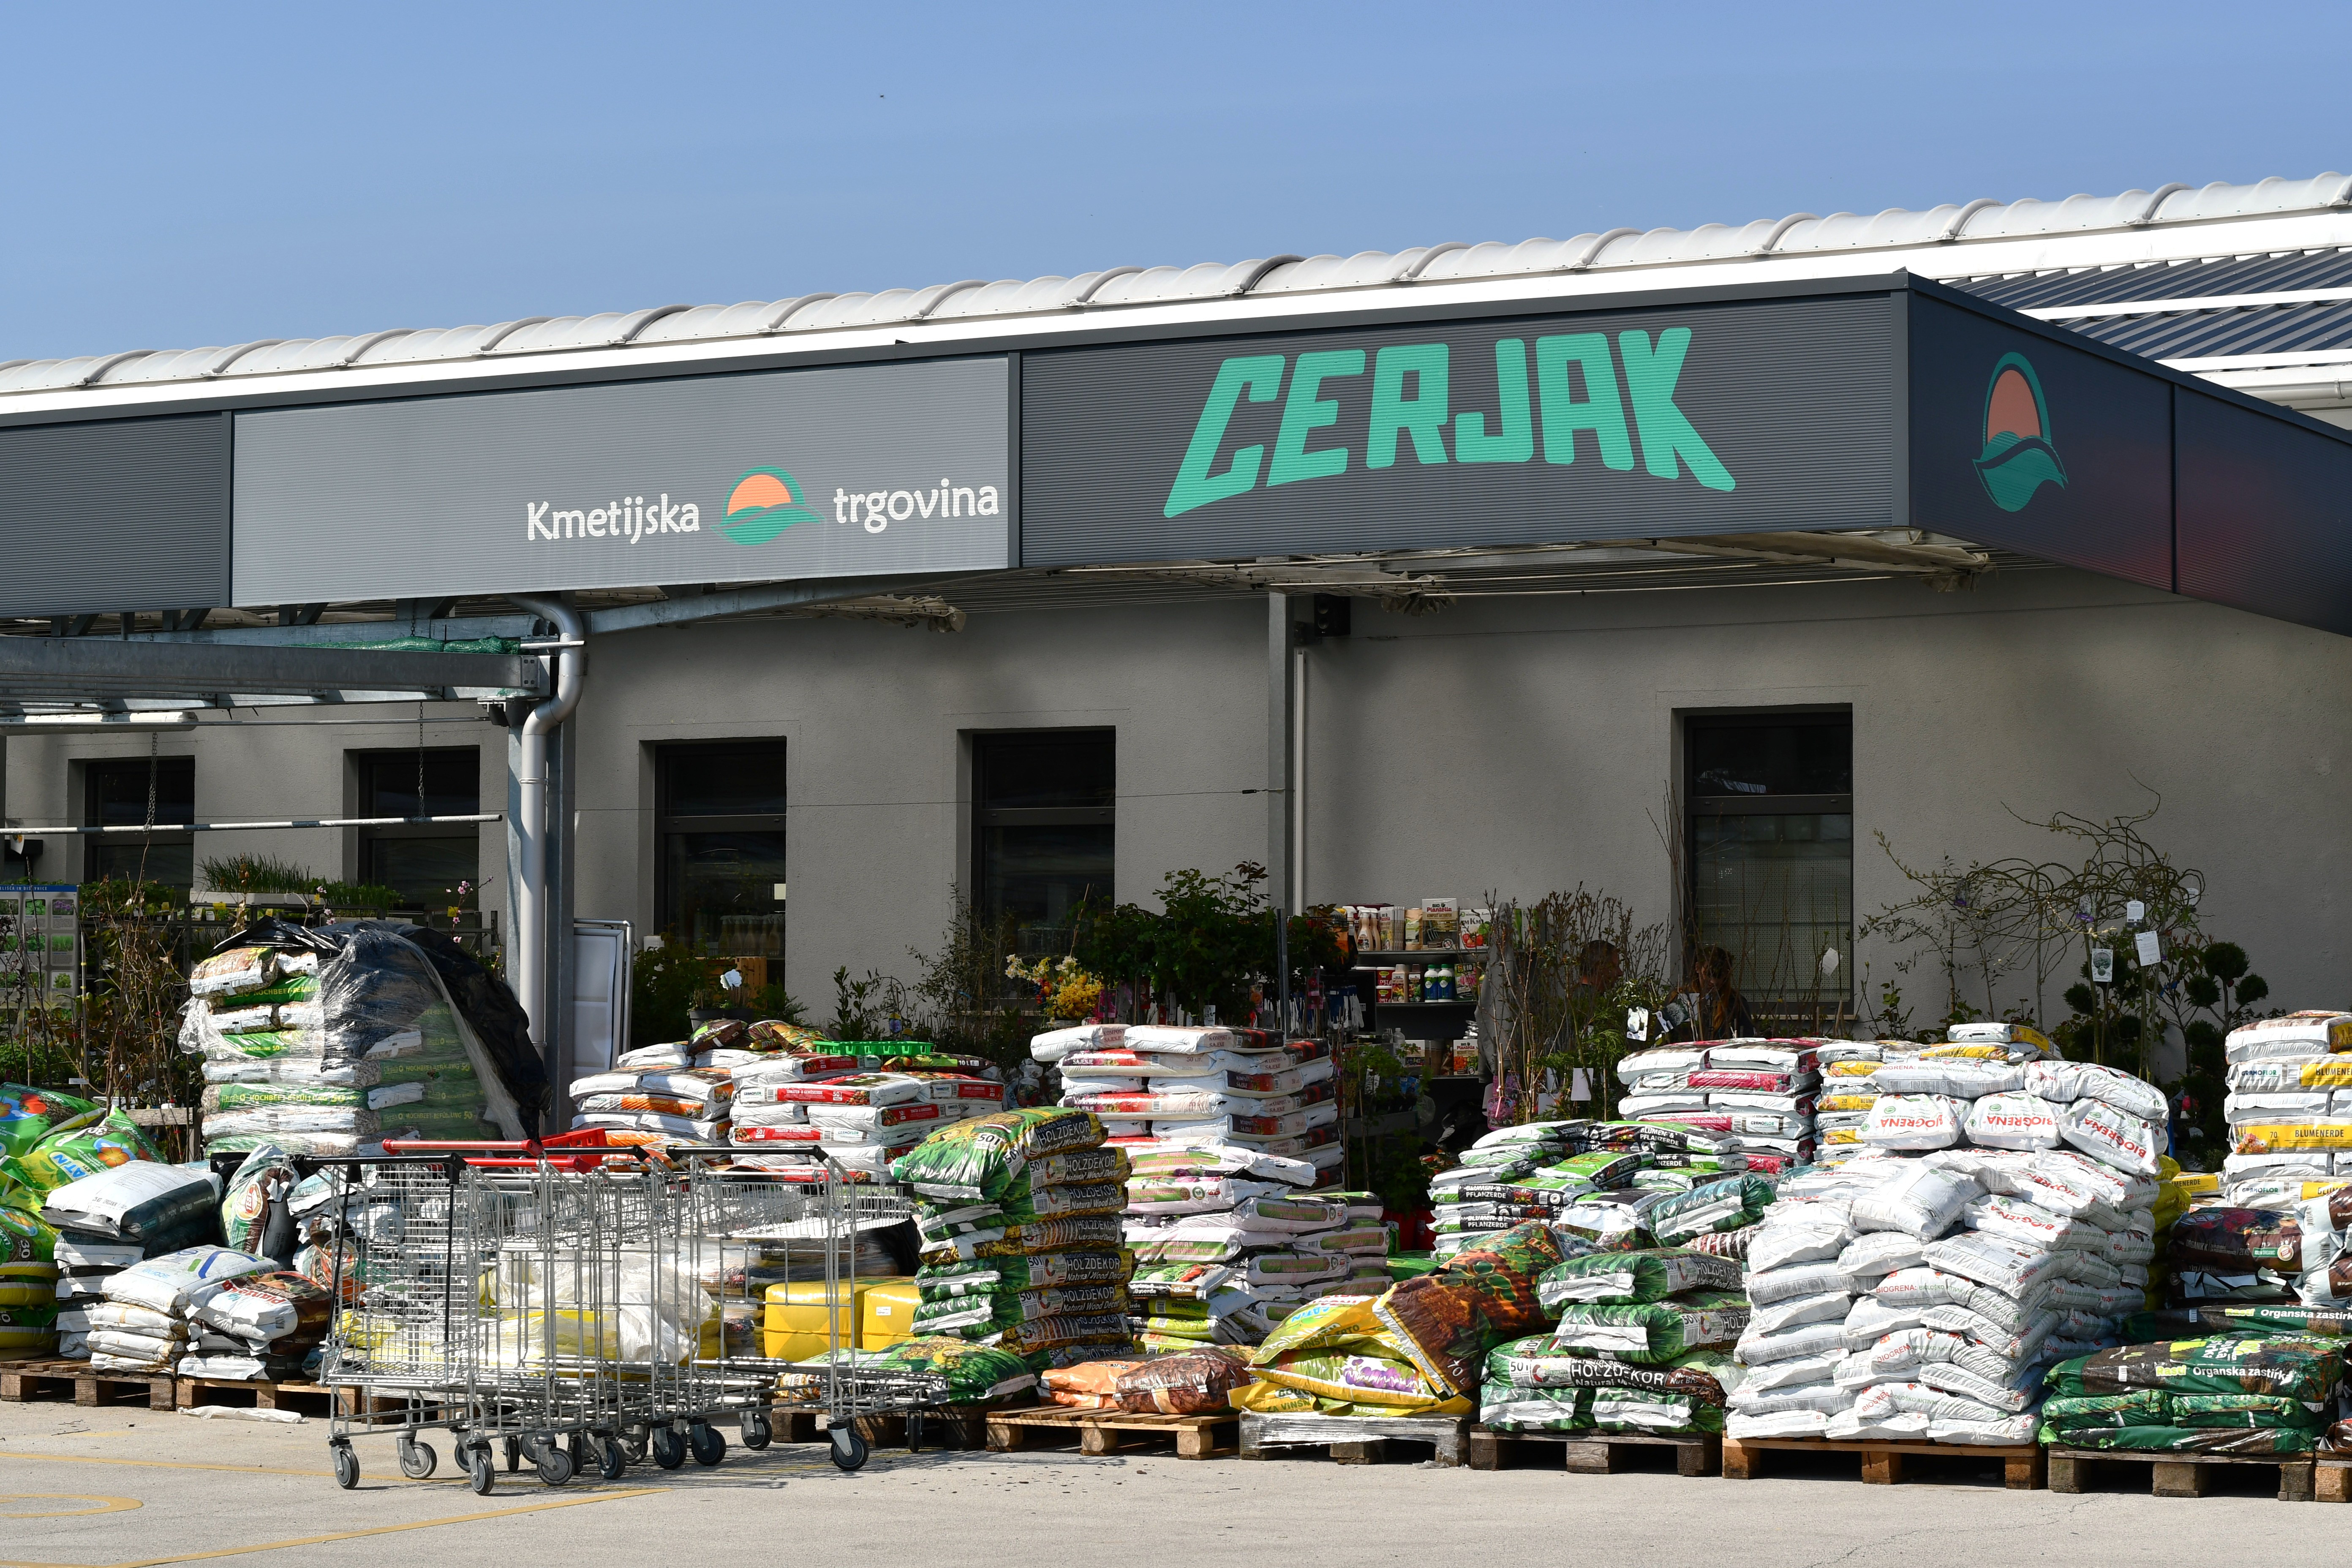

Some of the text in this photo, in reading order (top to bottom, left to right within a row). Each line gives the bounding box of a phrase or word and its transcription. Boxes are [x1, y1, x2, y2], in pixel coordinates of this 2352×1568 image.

[1164, 327, 1736, 518] CERJAK
[527, 478, 999, 544] Kmetijska trgovina
[1881, 1114, 1943, 1127] BIOGRENA
[1987, 1116, 2053, 1127] BIOGRENA
[1035, 1122, 1056, 1134] Natürlich
[1038, 1121, 1091, 1146] HOLZDEKOR
[2295, 1129, 2344, 1137] BLUMENERDE
[1039, 1135, 1096, 1154] Natural Wood Decor
[1640, 1134, 1679, 1146] PFLANZERDE
[2084, 1118, 2146, 1158] BIOGRENA
[1066, 1154, 1116, 1171] HOLZDEKOR
[1064, 1168, 1119, 1182] Natural Wood Decor
[2174, 1179, 2201, 1187] MENERDE
[1067, 1184, 1117, 1199] HOLZDEKOR
[245, 1192, 253, 1211] TEST
[1071, 1197, 1122, 1210] Natural Wood Decor
[1077, 1220, 1116, 1231] HOLZDEKOR
[20, 1239, 30, 1258] 30
[1067, 1258, 1120, 1271] HOLZDEKOR
[1066, 1271, 1091, 1282] Natural
[1696, 1263, 1737, 1280] HOLZDEKOR
[1062, 1287, 1115, 1302] HOLZDEKOR
[1876, 1285, 1917, 1293] BIOGRENA:
[1062, 1302, 1086, 1312] Natural
[1086, 1302, 1103, 1310] Wood
[1171, 1302, 1201, 1310] GRAMOFLOR
[2260, 1309, 2314, 1320] Organska
[2316, 1311, 2352, 1320] zastirk
[1722, 1315, 1750, 1329] HOLZD
[1081, 1327, 1097, 1335] Natural
[1334, 1324, 1360, 1335] TRTO
[1723, 1331, 1742, 1341] Natur
[1769, 1328, 1797, 1337] BIOLOŠKO
[1298, 1336, 1326, 1350] VINSK
[1571, 1364, 1664, 1386] HOLZDEKOR
[2156, 1364, 2187, 1377] Rasti
[2193, 1367, 2246, 1377] Organska
[1576, 1378, 1614, 1387] Natural
